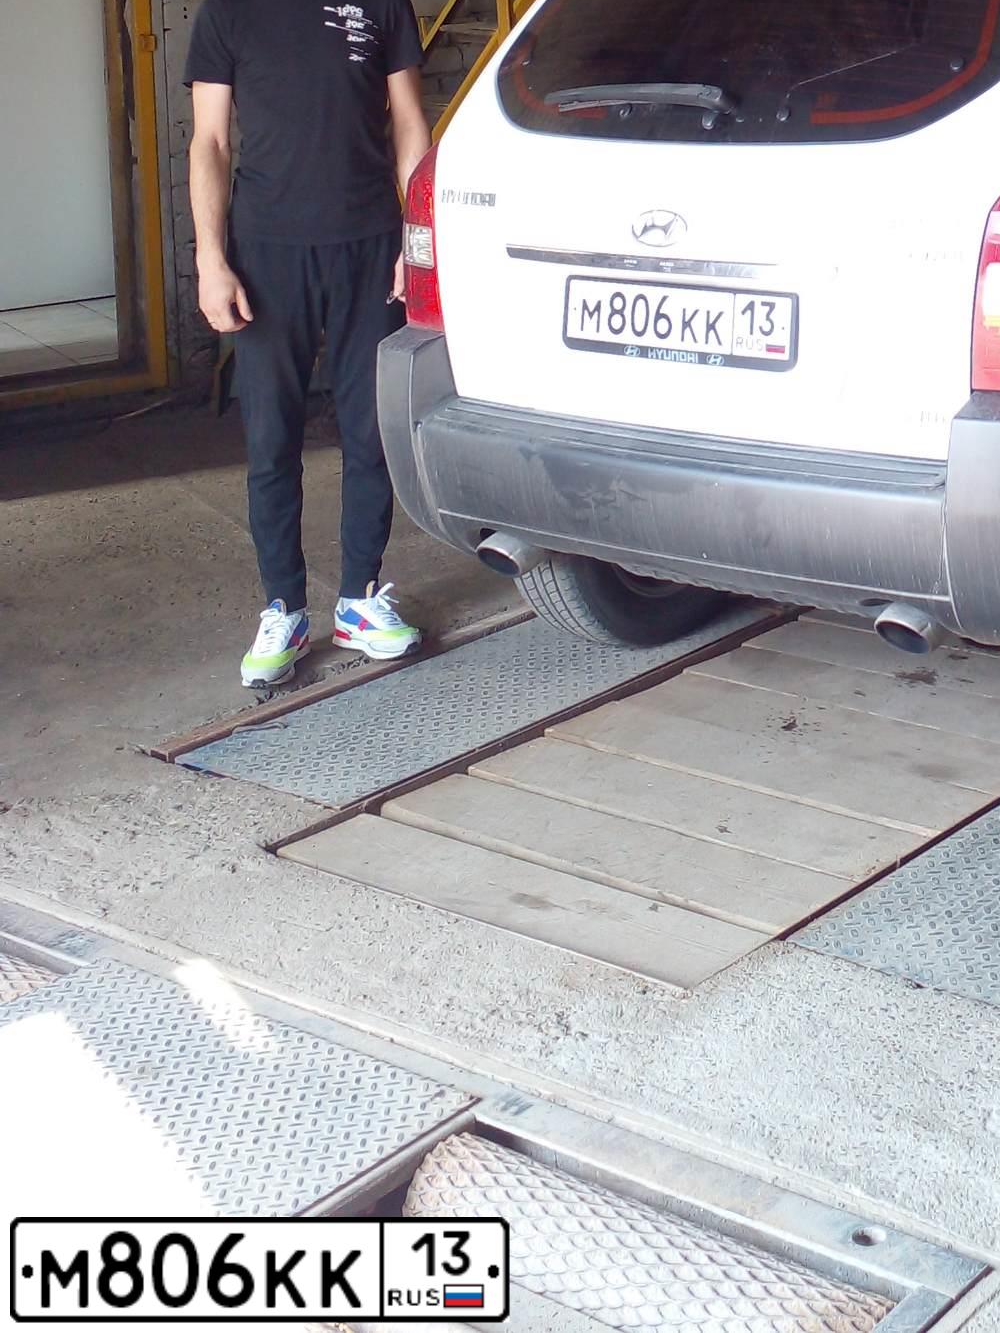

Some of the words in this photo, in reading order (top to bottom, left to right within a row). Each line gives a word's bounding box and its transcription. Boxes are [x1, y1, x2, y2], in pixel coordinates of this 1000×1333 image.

[580, 291, 725, 346] M806KK
[740, 299, 777, 337] 13
[735, 336, 763, 351] RUS
[647, 347, 699, 364] HYUNDAI
